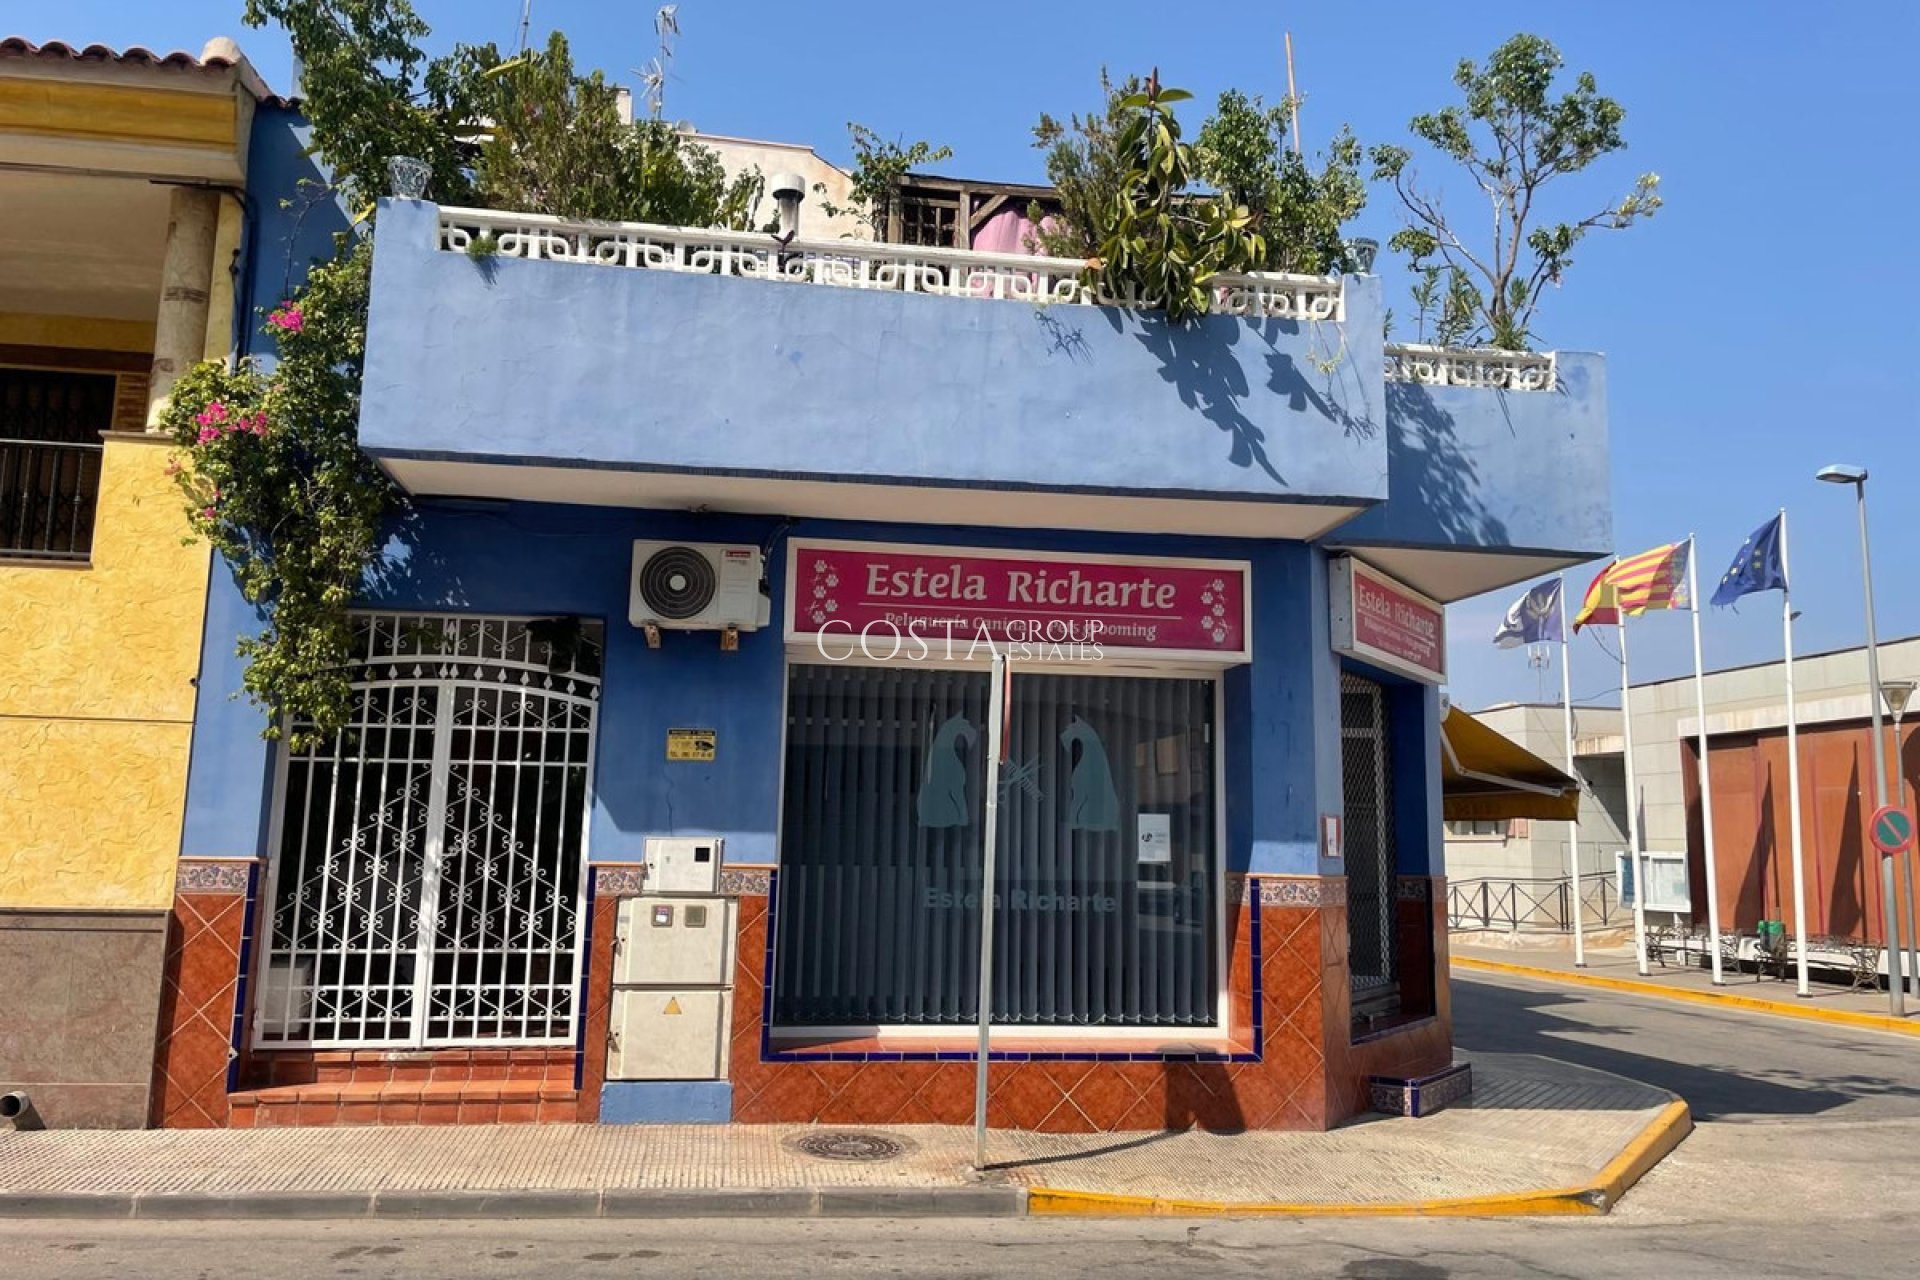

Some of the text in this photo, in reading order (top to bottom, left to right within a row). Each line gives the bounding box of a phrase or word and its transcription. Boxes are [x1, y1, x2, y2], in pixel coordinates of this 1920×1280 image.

[866, 563, 1177, 609] Estela Richarte
[1359, 584, 1391, 618] Estela
[923, 887, 1117, 913] Estea Richarte
